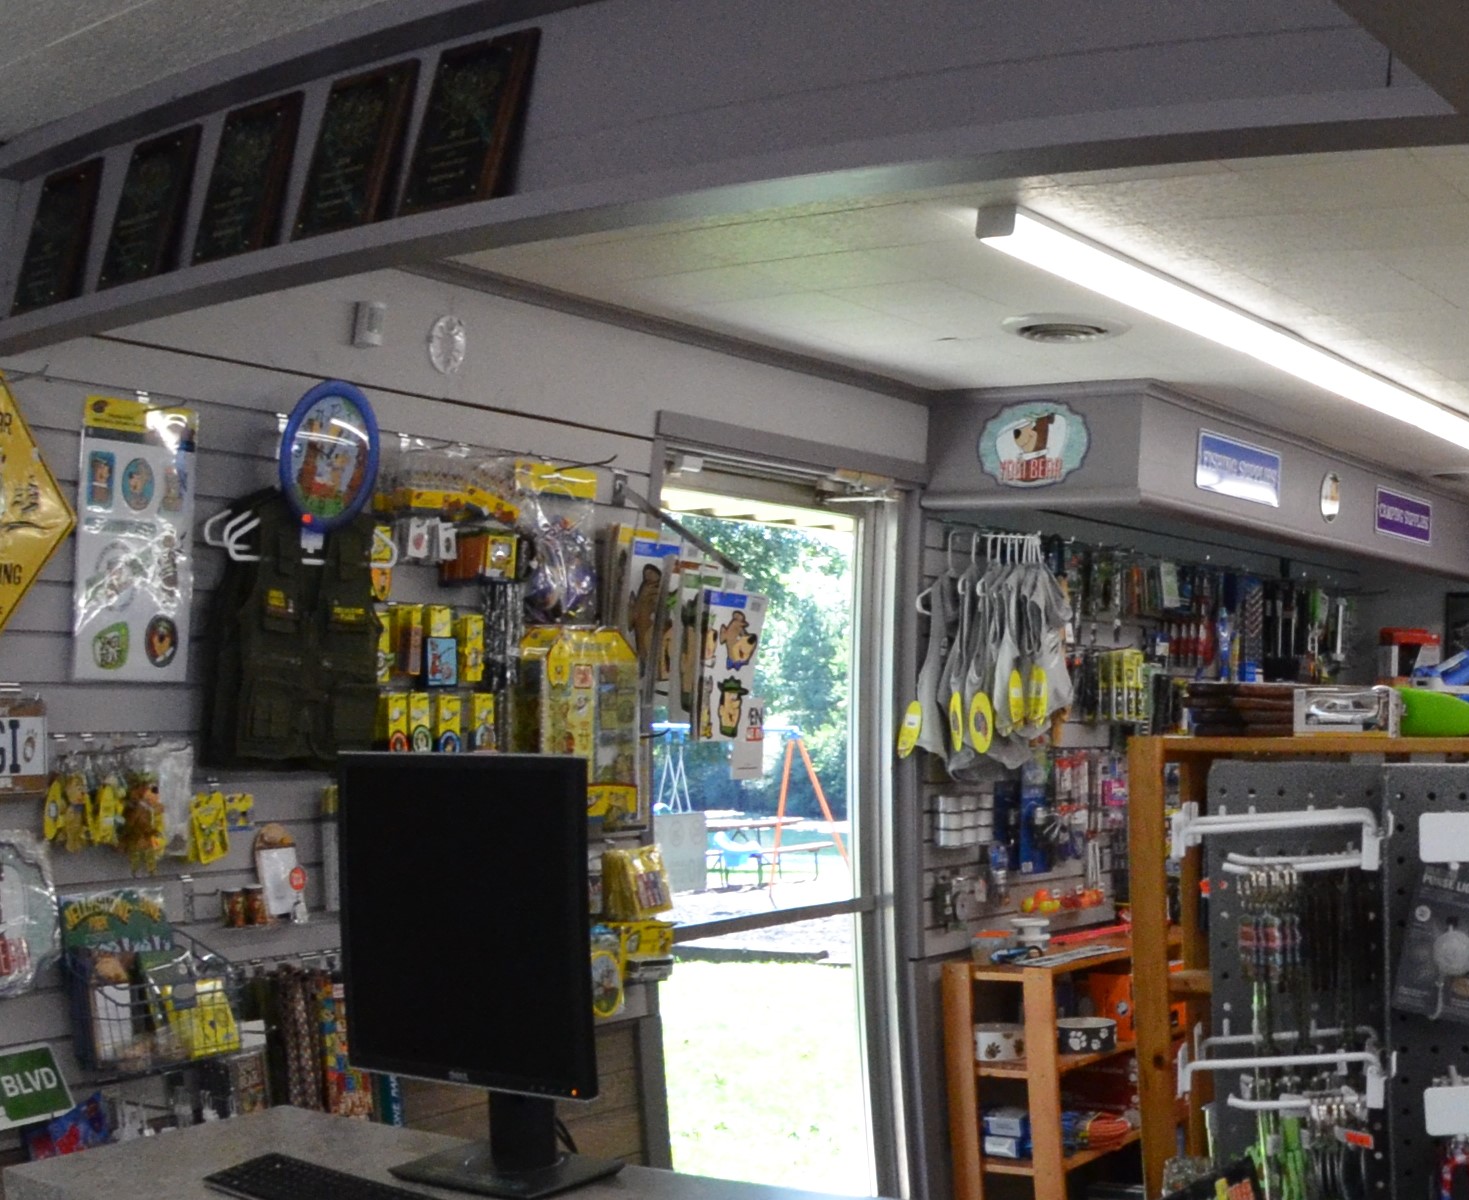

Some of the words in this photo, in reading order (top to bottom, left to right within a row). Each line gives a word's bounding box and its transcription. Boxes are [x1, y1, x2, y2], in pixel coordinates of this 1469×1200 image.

[1202, 450, 1238, 473] FISHING
[1239, 459, 1278, 484] SUPPLIES
[1378, 501, 1403, 524] CAMPING
[1404, 510, 1430, 532] SUPPLIES
[1, 1066, 58, 1098] BLVD
